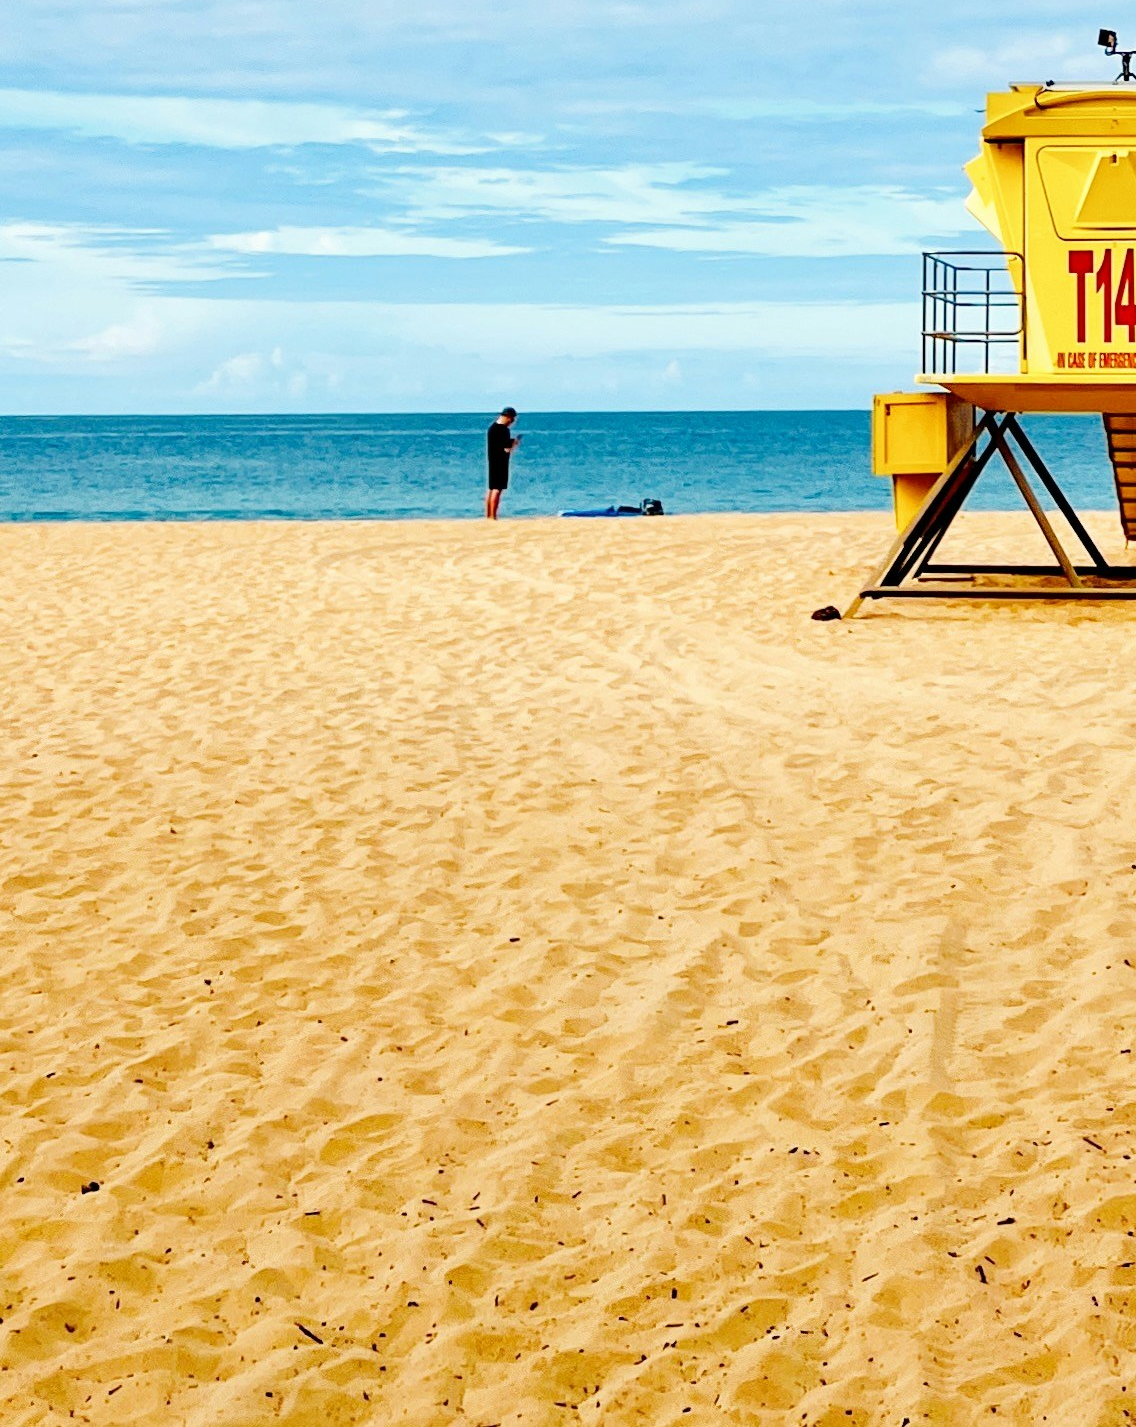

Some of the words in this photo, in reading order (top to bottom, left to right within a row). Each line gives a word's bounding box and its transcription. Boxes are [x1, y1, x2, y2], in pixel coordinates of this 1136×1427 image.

[1057, 352, 1065, 368] IN
[1068, 352, 1085, 368] CASE
[1088, 352, 1097, 368] OF
